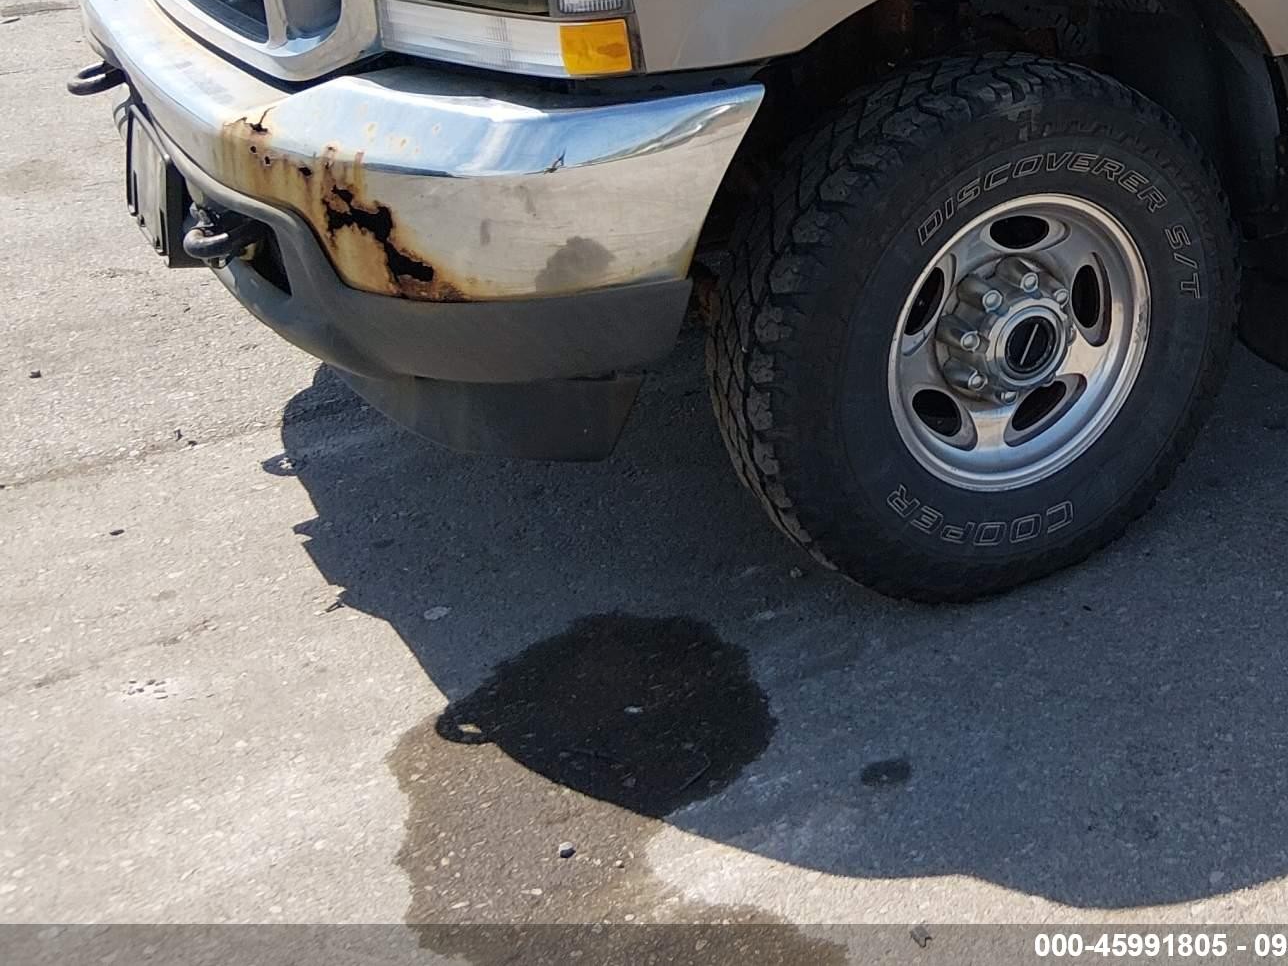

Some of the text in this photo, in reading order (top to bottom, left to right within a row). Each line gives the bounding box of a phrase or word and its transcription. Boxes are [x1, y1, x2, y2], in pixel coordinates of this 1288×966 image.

[917, 151, 1201, 299] DISCOVERER S/T
[886, 484, 1074, 546] COOPER
